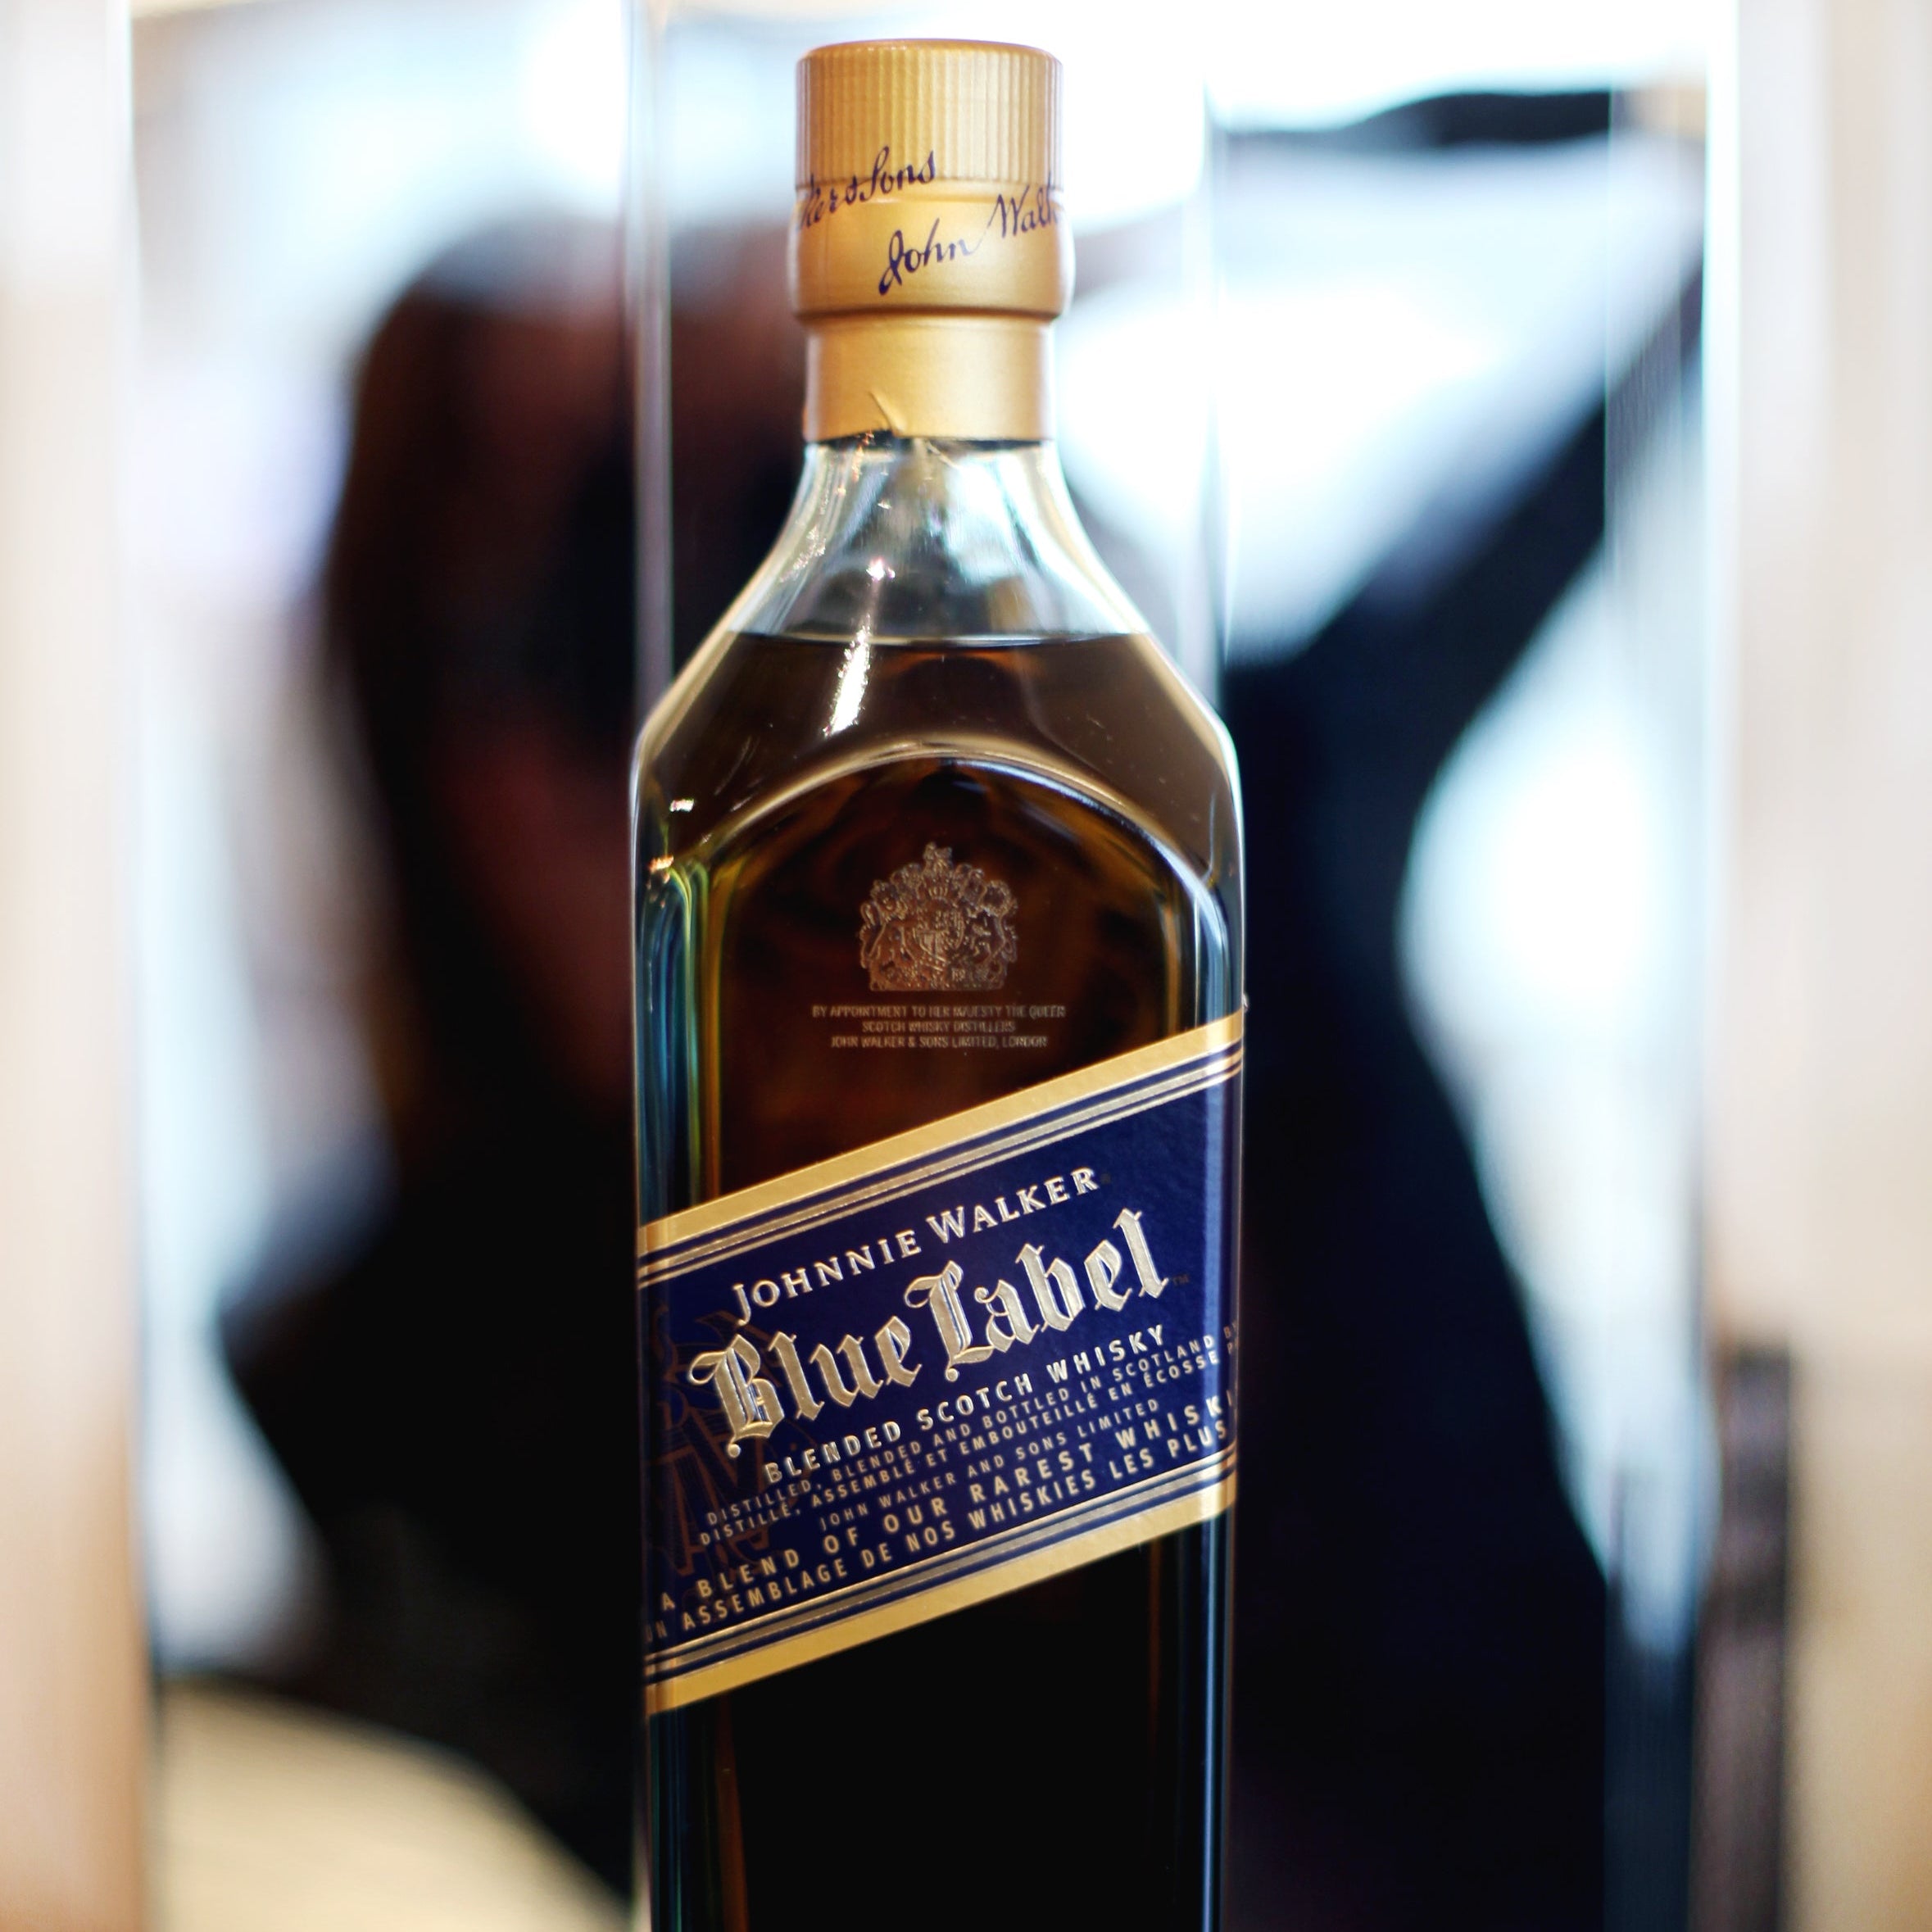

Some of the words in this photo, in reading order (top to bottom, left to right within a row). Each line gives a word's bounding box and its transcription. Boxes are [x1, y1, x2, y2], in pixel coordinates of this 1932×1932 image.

[878, 217, 977, 296] John
[812, 1005, 827, 1018] BY
[830, 1005, 907, 1018] APPOINTMENT
[912, 1005, 926, 1018] TO
[929, 1005, 950, 1018] HER
[953, 1005, 1002, 1018] MAJESTY
[1005, 1005, 1026, 1018] THE
[1029, 1005, 1066, 1019] QUEEN
[831, 1035, 859, 1048] JOHN
[861, 1035, 905, 1048] WALKER
[908, 1035, 916, 1048] &
[918, 1035, 949, 1048] SONS
[1002, 1035, 1048, 1048] LONDON
[862, 1020, 905, 1032] SCOTCH
[909, 1020, 950, 1032] WHISKY
[954, 1020, 1016, 1032] DISTILLERS
[732, 1230, 923, 1327] JOHNNIE
[927, 1166, 1100, 1244] WALKER
[687, 1314, 923, 1458] Blue
[904, 1207, 1170, 1382] Label
[764, 1421, 902, 1484] BLENDED
[916, 1372, 1033, 1431] SCOTCH
[1046, 1324, 1163, 1383] WHISKY
[701, 1503, 801, 1547] DISTILLÉ,
[813, 1459, 916, 1508] ASSEMBLÉ
[926, 1449, 948, 1467] ET
[959, 1392, 1098, 1455] EMBOUTEILLÉ
[1109, 1382, 1133, 1402] EN
[1143, 1349, 1220, 1388] ÉCOSSE
[707, 1480, 822, 1526] DISTILLED,
[832, 1440, 923, 1482] BLENDED
[932, 1424, 971, 1447] AND
[982, 1388, 1069, 1429] BOTTLED
[1081, 1376, 1102, 1393] IN
[1113, 1334, 1215, 1382] SCOTLAND
[820, 1503, 868, 1531] JOHN
[879, 1472, 957, 1508] WALKER
[968, 1454, 1005, 1478] AND
[1016, 1431, 1067, 1460] SONS
[1077, 1398, 1159, 1438] LIMITED
[662, 1591, 676, 1611] A
[697, 1549, 800, 1599] BLEND
[823, 1526, 859, 1554] OF
[884, 1496, 948, 1534] OUR
[969, 1442, 1094, 1504] RAREST
[682, 1558, 848, 1630] ASSEMBLAGE
[861, 1543, 893, 1568] DE
[905, 1520, 955, 1553] NOS
[968, 1469, 1097, 1531] WHISKIES
[1109, 1448, 1154, 1479] LES
[1167, 1420, 1227, 1458] PLUS
